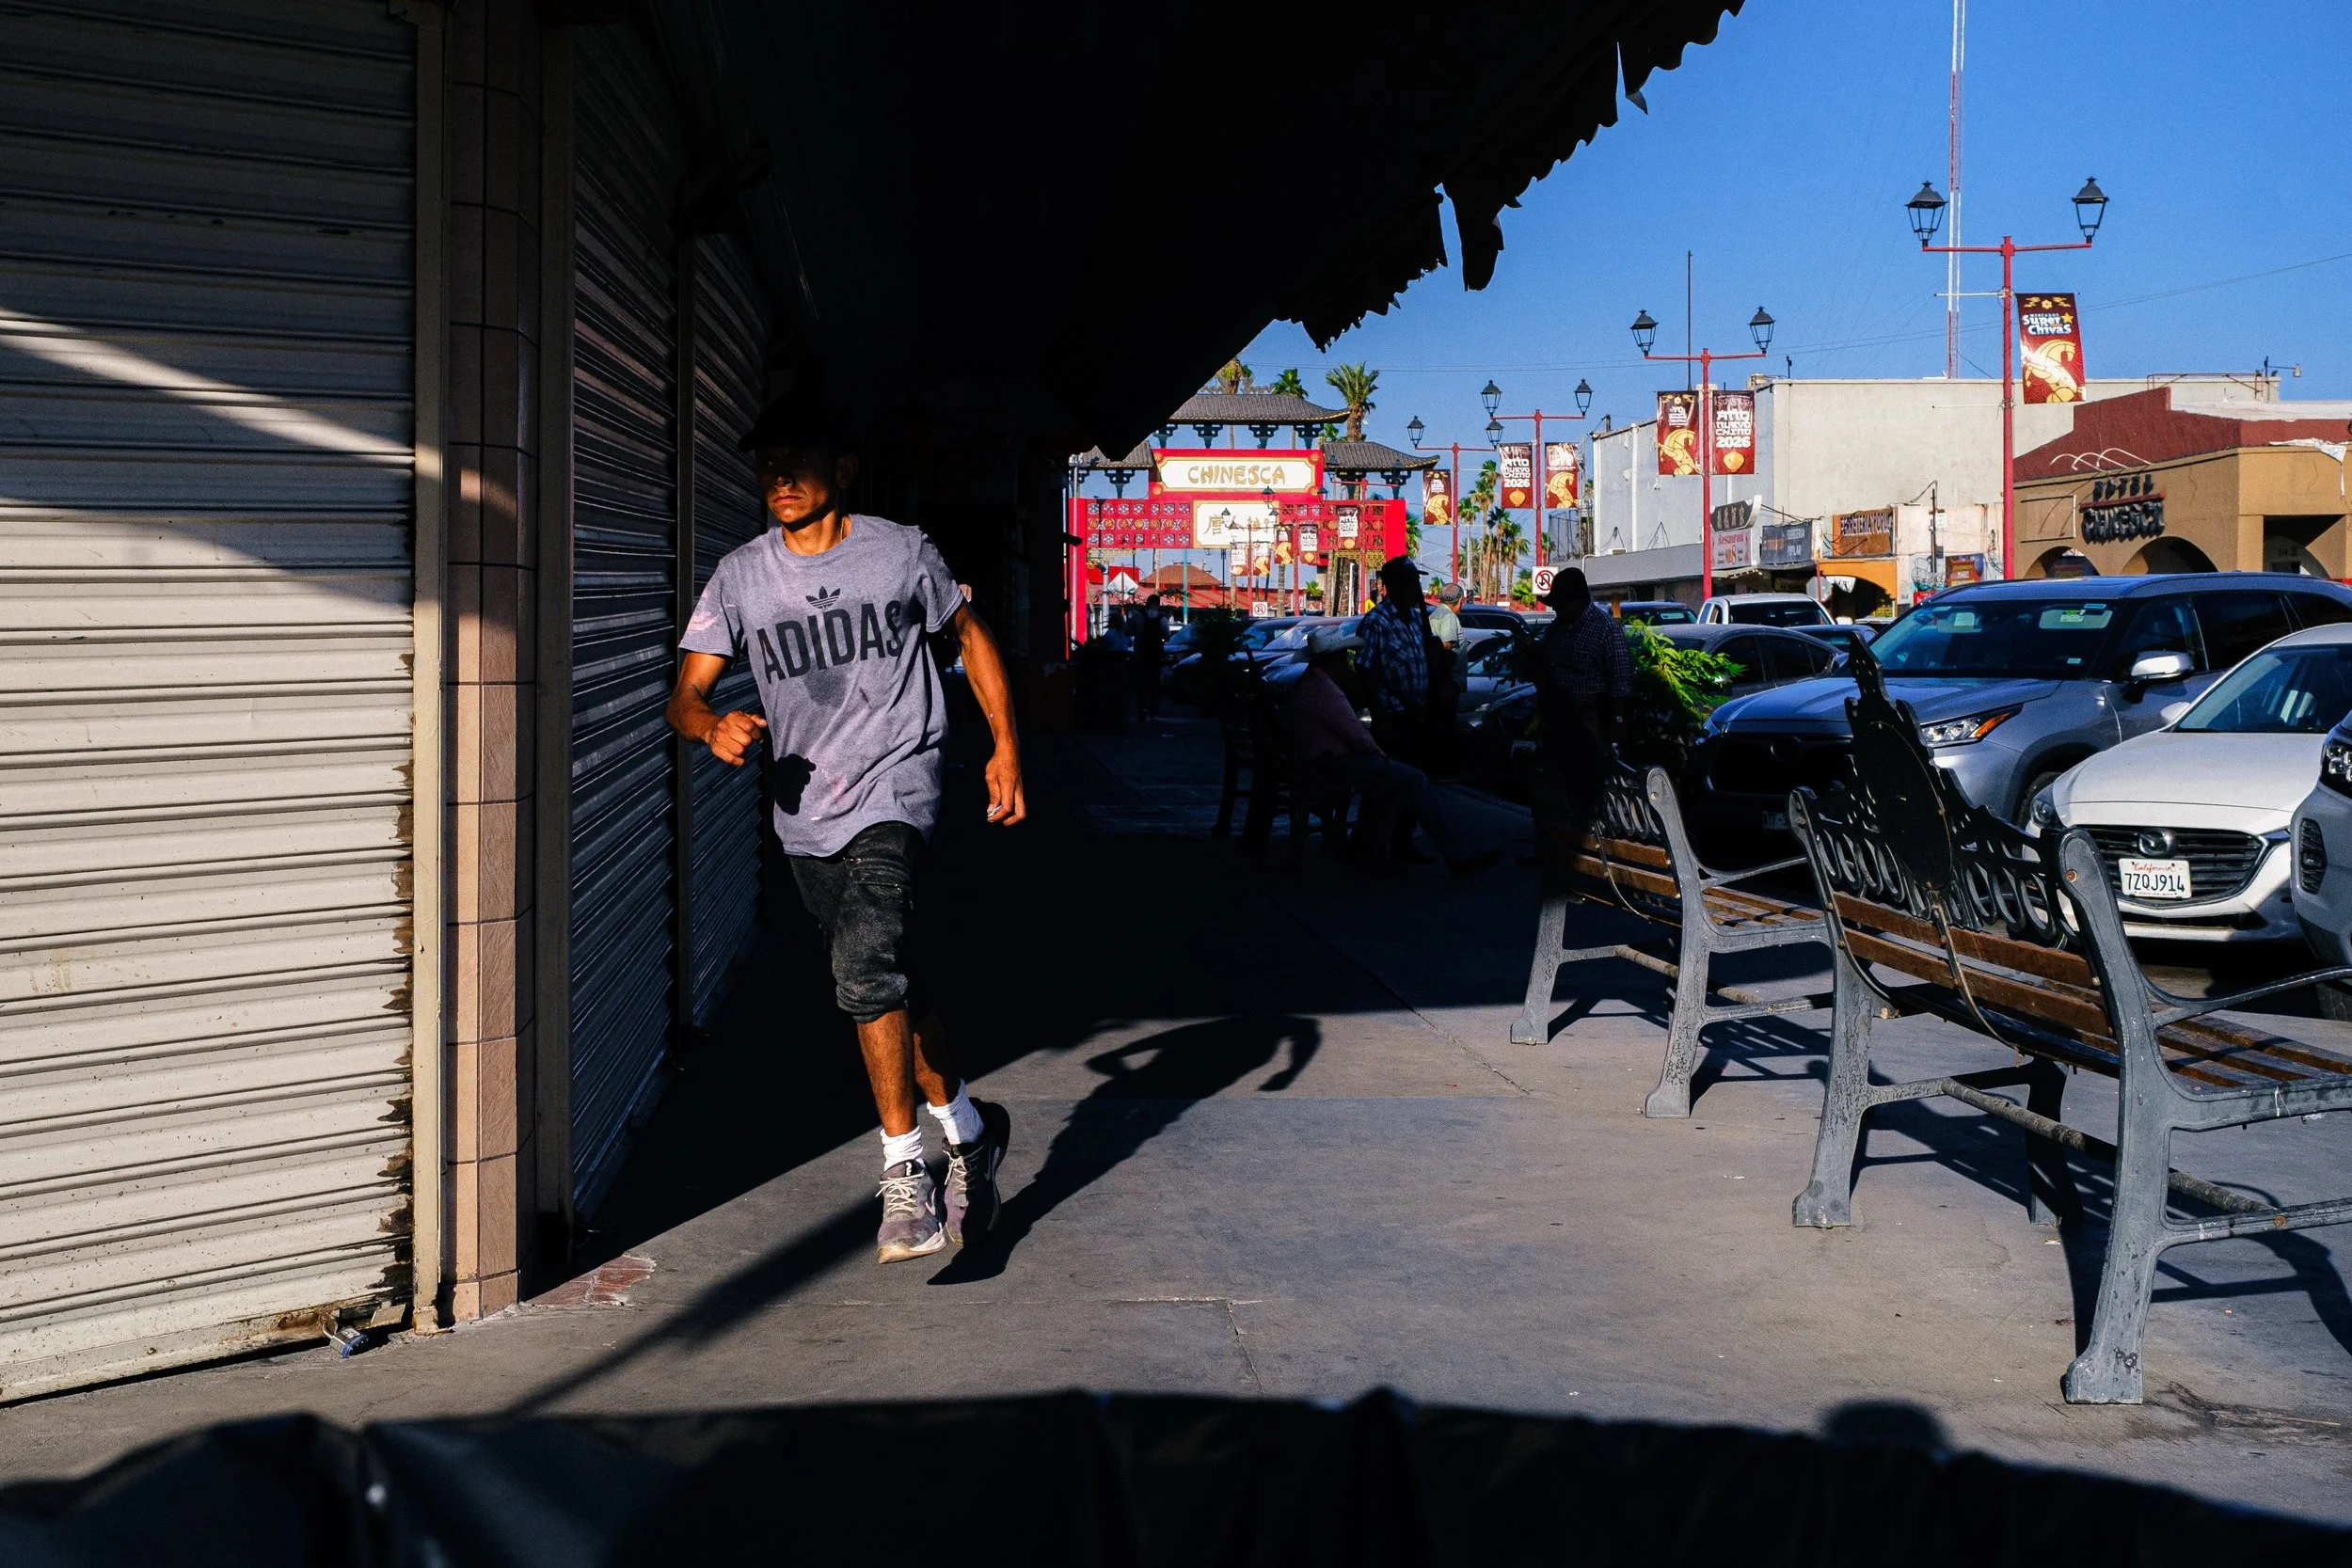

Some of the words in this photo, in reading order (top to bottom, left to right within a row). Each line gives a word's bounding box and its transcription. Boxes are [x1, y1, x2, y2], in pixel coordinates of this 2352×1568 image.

[2022, 315, 2061, 326] Super
[2027, 324, 2073, 336] Chivas
[1716, 436, 1752, 449] 2026
[1187, 465, 1286, 485] CHINESCA
[1503, 479, 1531, 488] 2026
[756, 600, 901, 685] ADIDAS
[2134, 863, 2175, 873] California
[2124, 873, 2185, 892] 7ZQJ914
